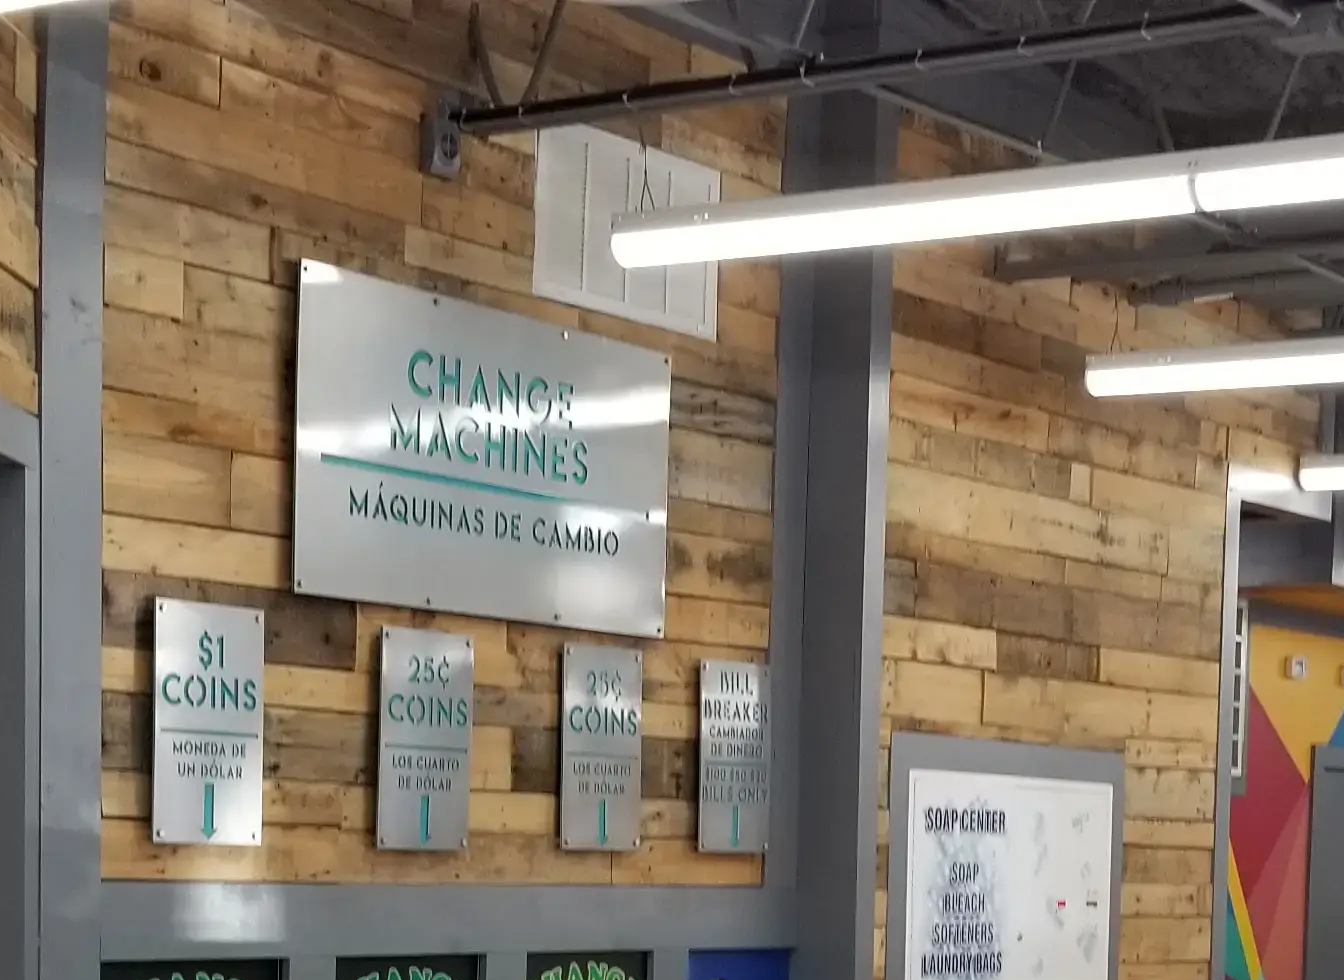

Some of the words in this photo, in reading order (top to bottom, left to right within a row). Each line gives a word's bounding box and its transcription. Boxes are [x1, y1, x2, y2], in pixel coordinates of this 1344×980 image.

[407, 348, 574, 430] CHANGE
[389, 401, 589, 486] MACHINES
[348, 481, 485, 536] MÁQUINAS
[494, 511, 522, 543] DE
[531, 517, 620, 557] CAMBIO
[198, 631, 225, 670] $1
[408, 654, 450, 689] 25¢
[720, 669, 754, 697] BILL
[161, 673, 257, 711] COINS
[387, 693, 468, 728] COINS
[568, 705, 637, 737] COINS
[704, 697, 768, 724] BREAKER
[172, 739, 226, 758] MONEDA
[232, 743, 247, 759] DE
[177, 762, 196, 779] UN
[200, 757, 244, 779] DÓLAR
[925, 806, 959, 834] SOAP
[959, 808, 1006, 835] CENTER
[949, 861, 979, 885] SOAP
[931, 921, 994, 946] SOFTENERS
[921, 952, 973, 978] LAUNDRY
[973, 952, 1002, 974] BAGS
